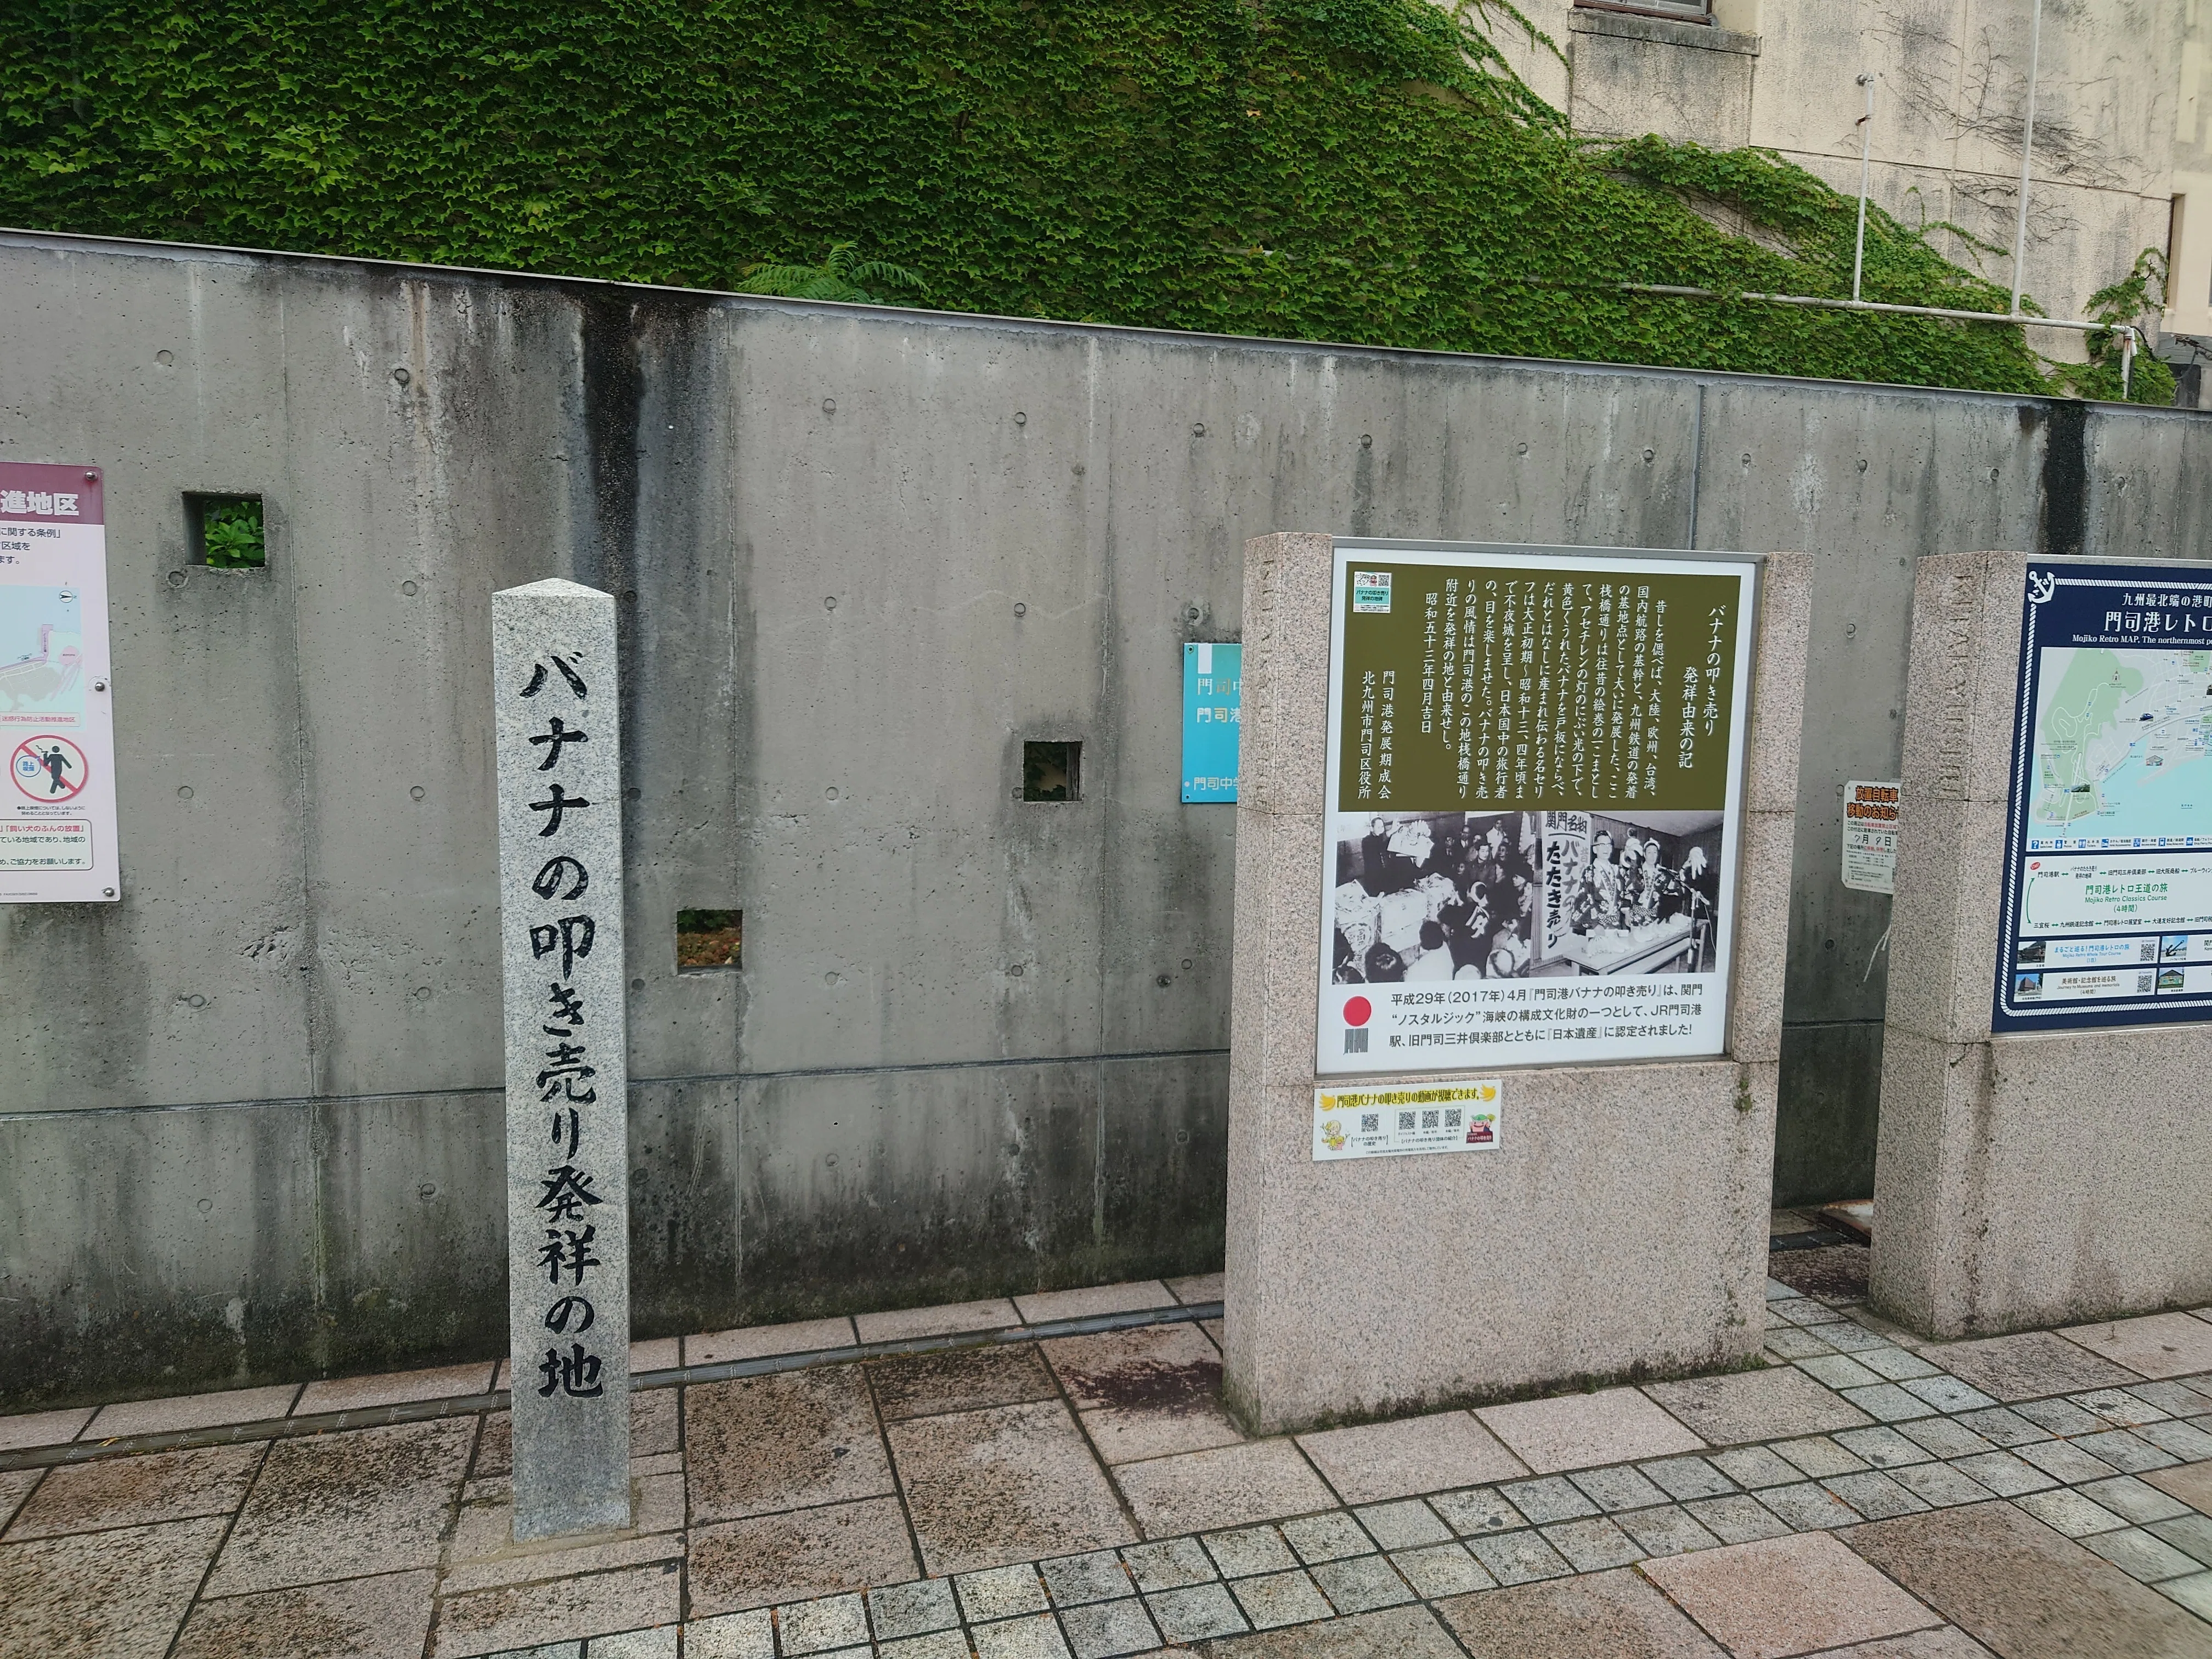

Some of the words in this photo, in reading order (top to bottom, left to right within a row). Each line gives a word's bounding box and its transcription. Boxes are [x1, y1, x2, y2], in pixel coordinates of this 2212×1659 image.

[0, 490, 80, 516] 進地区
[0, 541, 30, 551] 区域を
[1421, 593, 1437, 733] 昭和五十三年四月吉日
[1440, 579, 1458, 749] 附近を発祥の地と由来せし。
[2104, 612, 2212, 632] 門司港レトロ
[2122, 592, 2212, 608] 九州最北端の港町
[1358, 671, 1375, 799] 北九州市門司区役所
[1378, 670, 1395, 799] 門司港発展期成会
[1457, 579, 1476, 799] りの風情は門司港のこの地桟橋通り
[1475, 580, 1497, 799] の、目を楽しませた。バナナの叩き売
[1494, 580, 1518, 799] で不夜城を呈し、日本国中の旅行者
[1533, 582, 1555, 799] だれとはなしに産まれ伝わる名セリ
[1551, 583, 1574, 795] 黄色くうれたバナナを戸板にならべ、
[1571, 584, 1592, 795] て、アセチレンの灯のにぶい光の下で、
[1591, 584, 1612, 799] 桟橋通りは往昔の絵巻の一こまとし
[1609, 585, 1629, 799] の基地点として大いに発展した、ここ
[1625, 585, 1649, 799] 国内航路の基幹と、九州鉄道の発着
[1644, 600, 1667, 795] 昔しを偲べば、大陸、欧州、台湾、
[1678, 666, 1699, 768] 発祥由来の記
[1703, 605, 1726, 736] バナナの叩き売り
[1847, 802, 1899, 820] 移動のお知ら
[1855, 786, 1898, 803] 放置自転車
[1546, 840, 1562, 949] たたき売り
[2085, 883, 2168, 895] 門司港レトロ王道の旅
[518, 651, 603, 1400] バナナの叩き売り発祥の地
